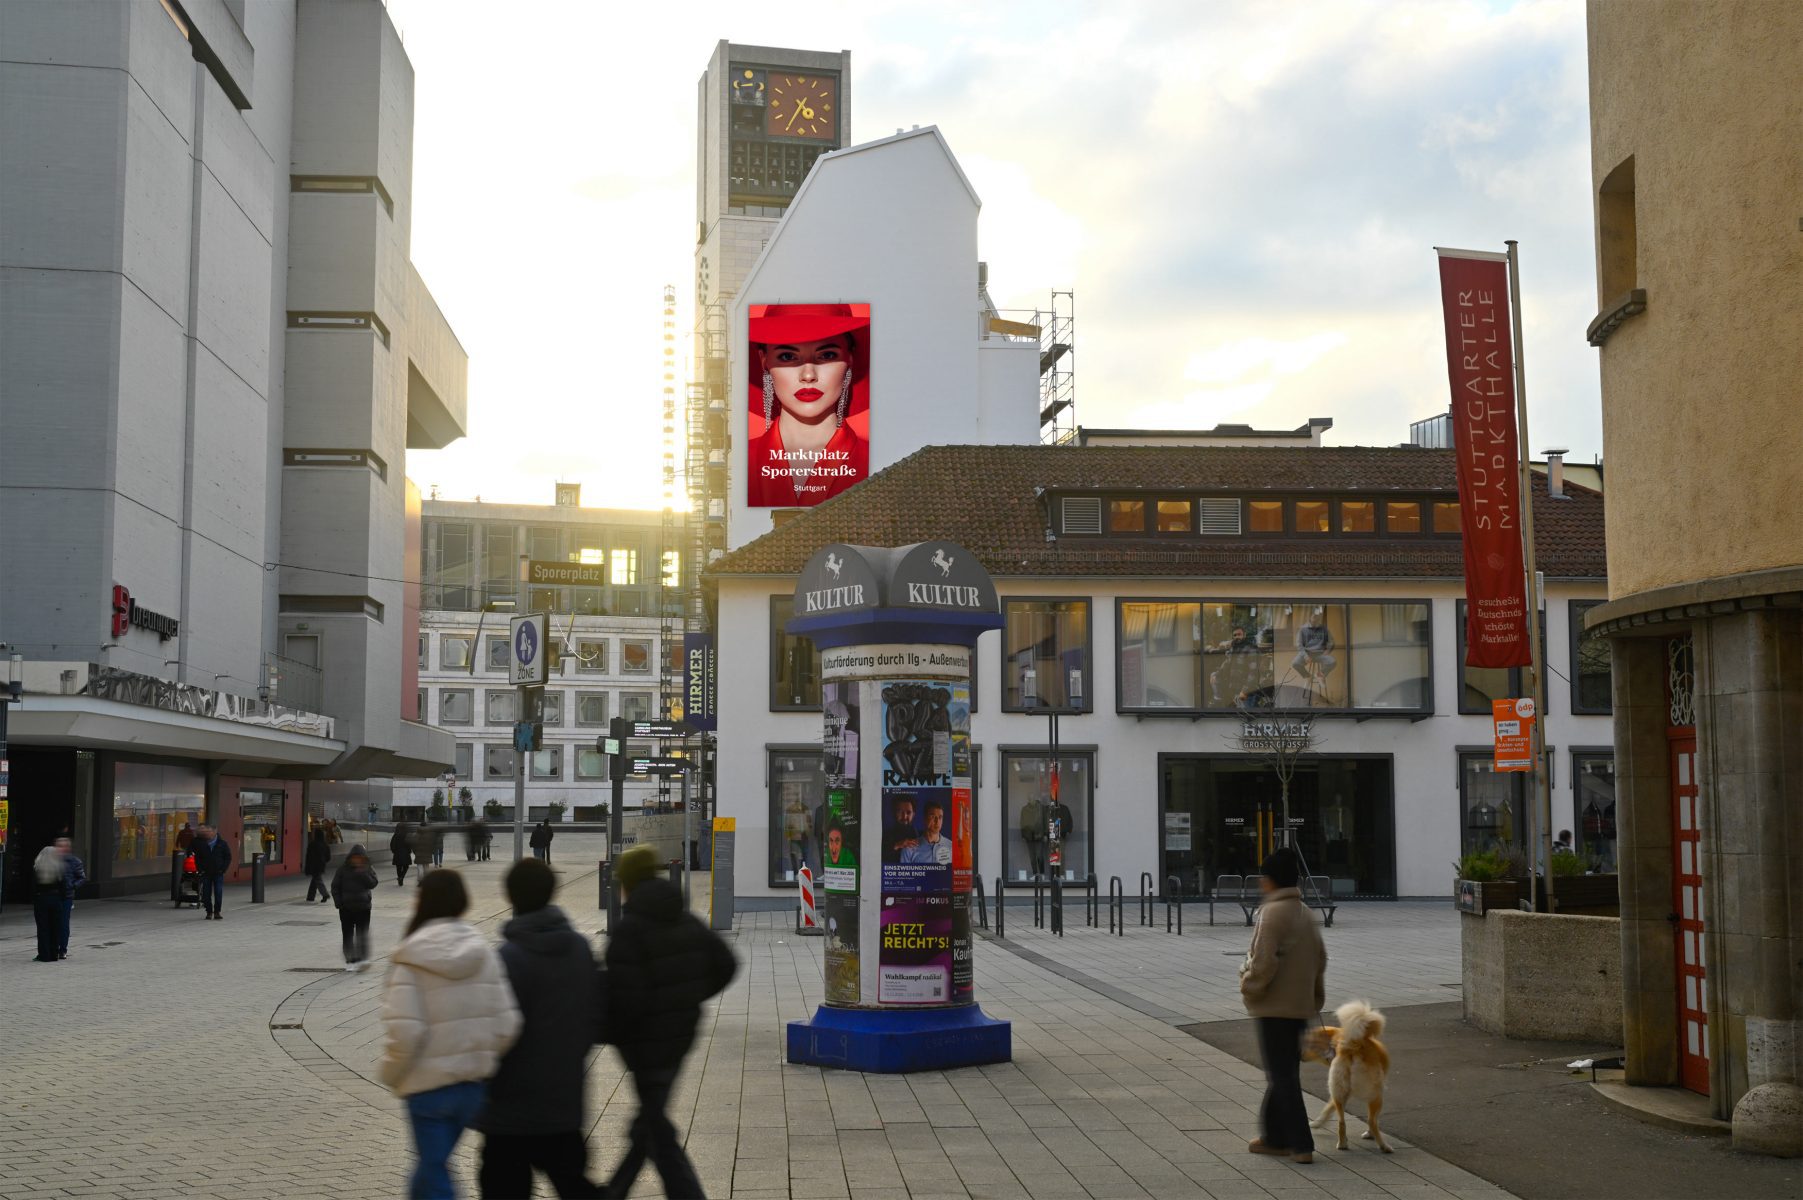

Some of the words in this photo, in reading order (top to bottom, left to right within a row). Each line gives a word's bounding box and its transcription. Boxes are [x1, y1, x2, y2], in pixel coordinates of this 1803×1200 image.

[1458, 289, 1491, 530] STUTTGARTER
[1478, 289, 1513, 529] MARKTHALLE
[769, 448, 850, 462] Marktplatz
[761, 464, 857, 479] Sporerstraße
[793, 484, 827, 492] Stuttgart
[534, 564, 599, 582] Sporerplatz
[805, 584, 865, 612] KULTUR
[907, 582, 981, 607] KULTUR
[877, 653, 904, 666] durch
[908, 652, 920, 666] Ilg
[517, 667, 534, 680] ZONE
[689, 649, 703, 715] HIRMER
[1243, 723, 1311, 737] HIRMER
[926, 897, 949, 905] FOKUS
[884, 923, 925, 935] JETZT
[884, 936, 949, 949] REICHT'S!
[884, 973, 922, 982] Wahlkampf
